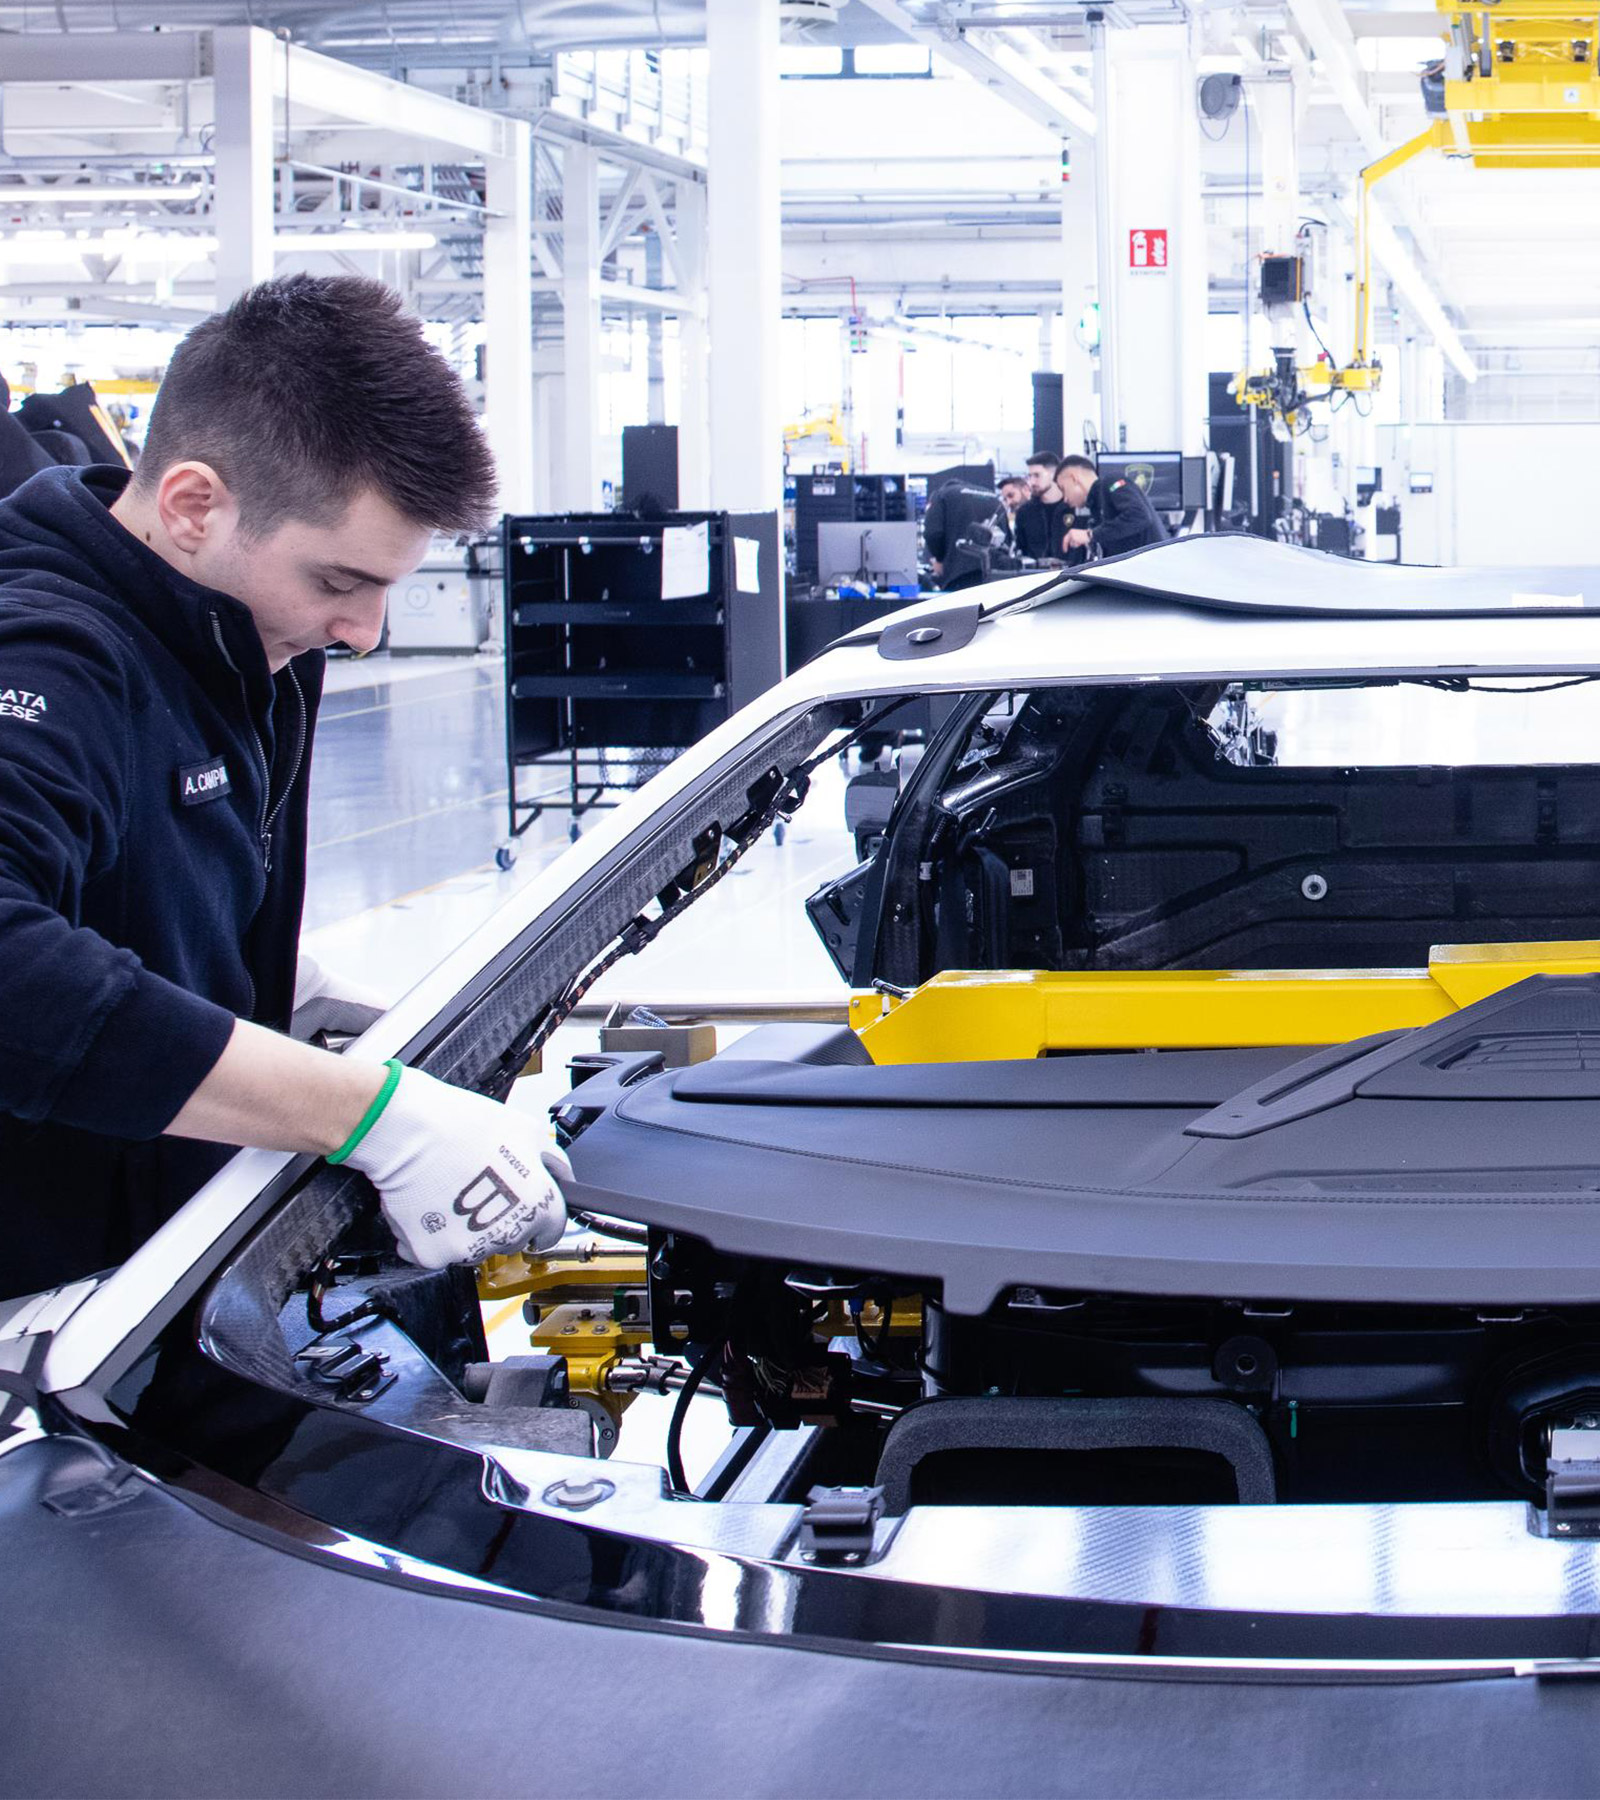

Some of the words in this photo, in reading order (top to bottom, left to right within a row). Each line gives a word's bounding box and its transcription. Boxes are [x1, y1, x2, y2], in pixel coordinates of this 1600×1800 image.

[0, 688, 47, 711] ATA
[453, 1165, 521, 1232] B
[467, 1203, 529, 1253] KRYTECH
